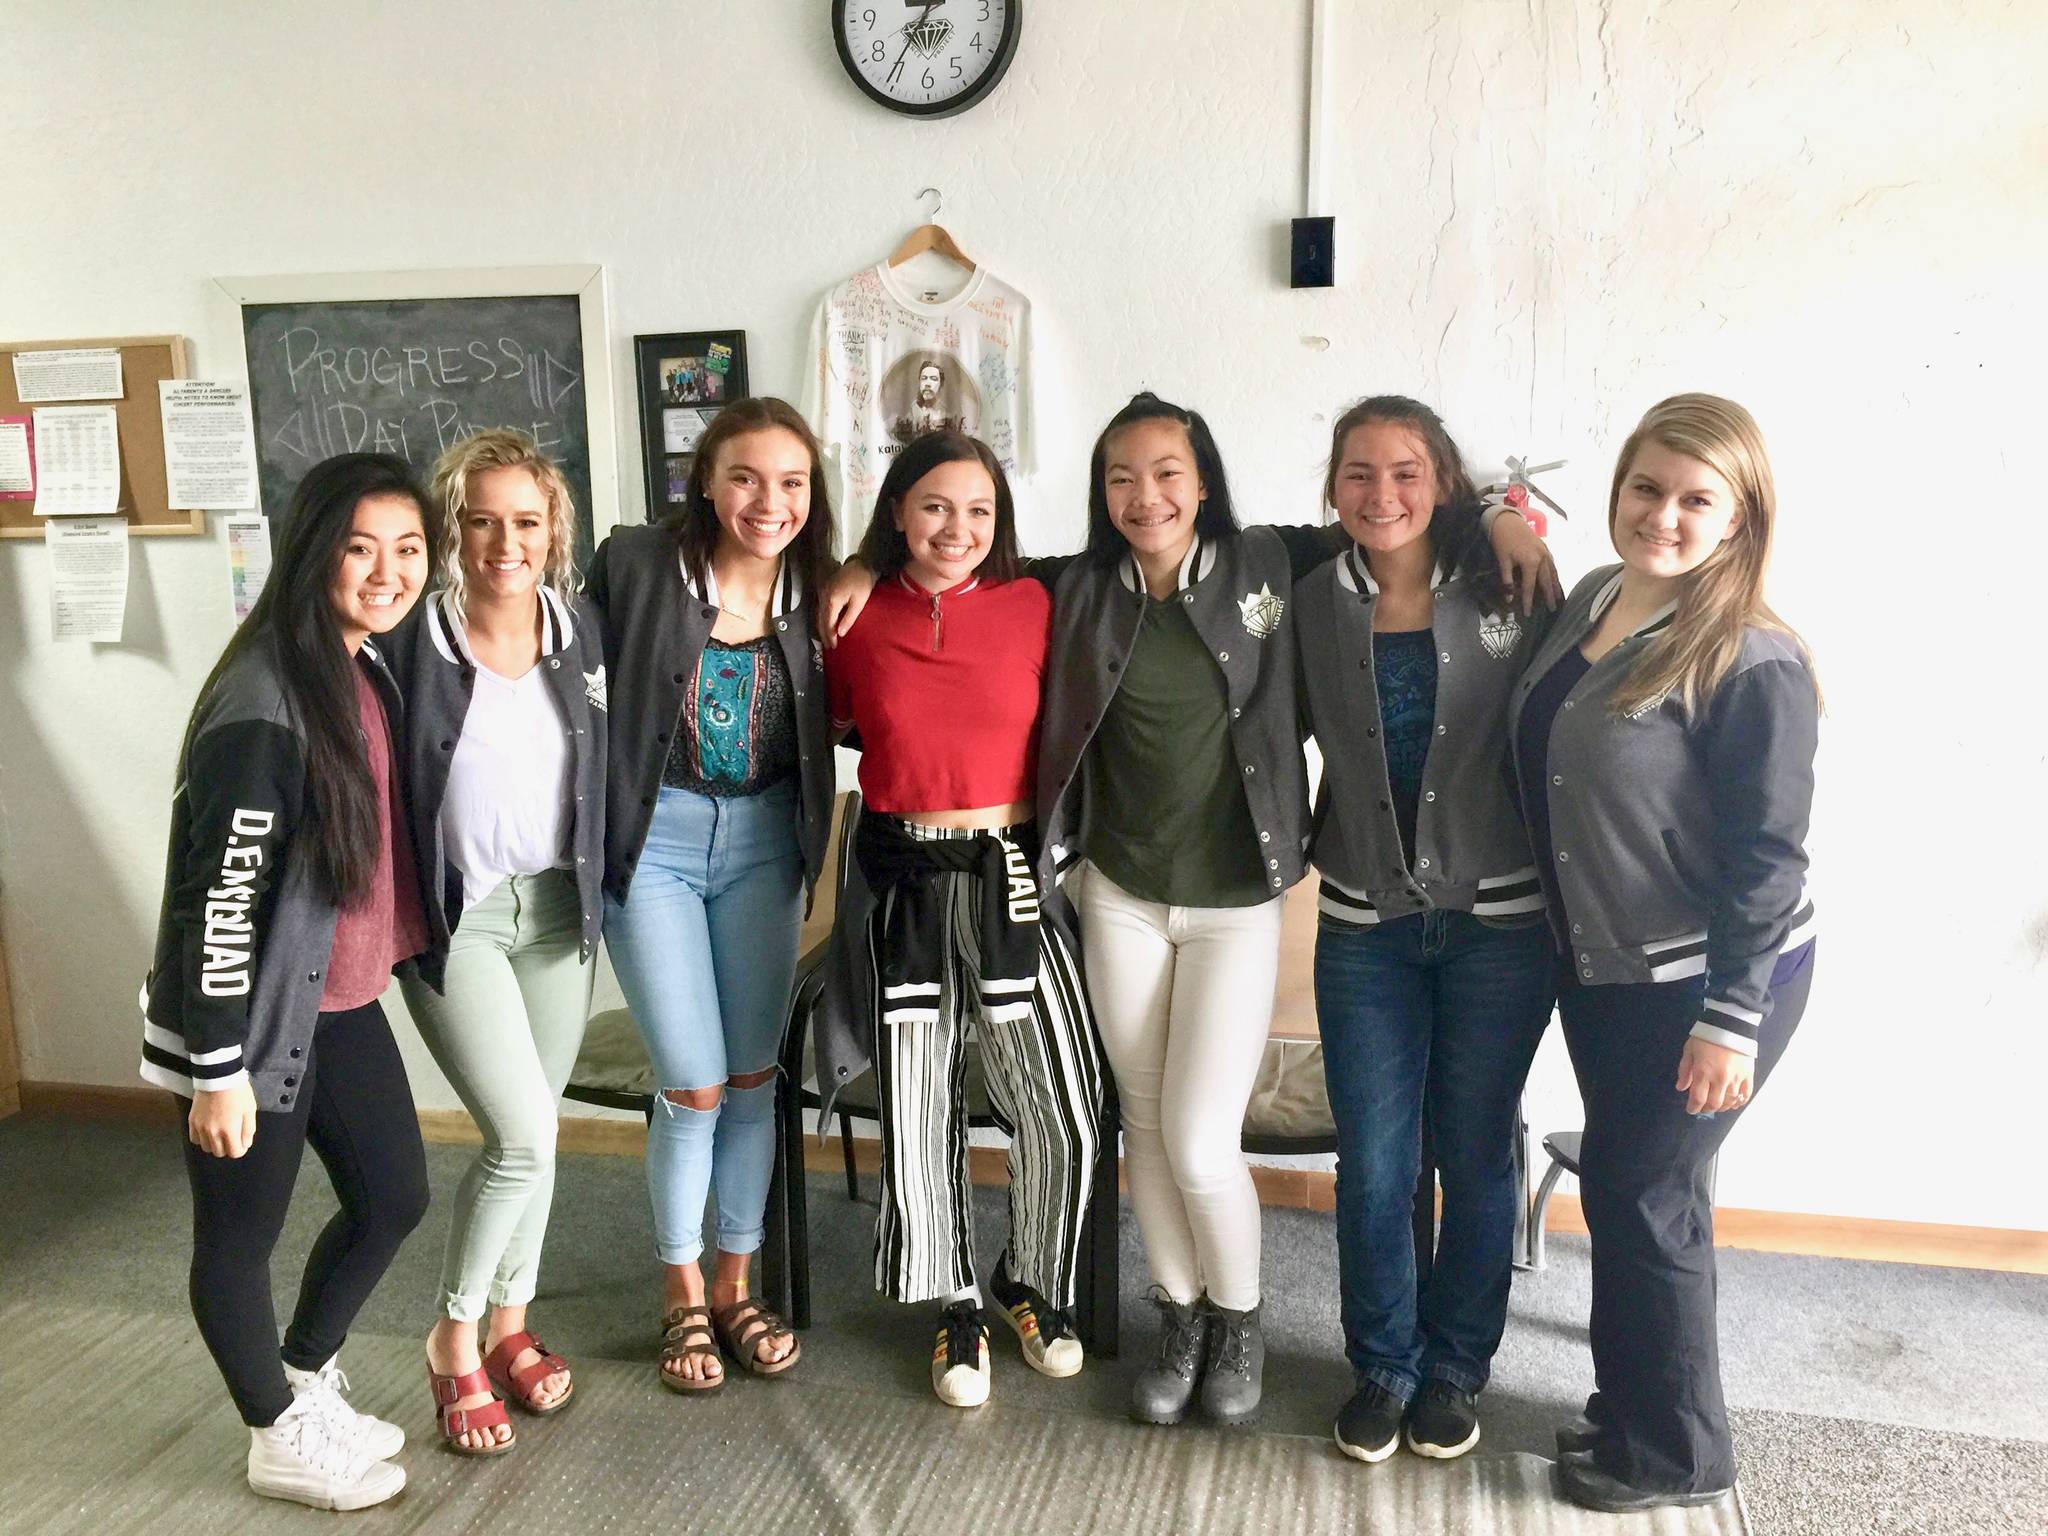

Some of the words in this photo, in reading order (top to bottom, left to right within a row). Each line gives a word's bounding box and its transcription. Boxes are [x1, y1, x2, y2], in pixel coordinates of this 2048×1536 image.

[862, 8, 876, 32] 9
[977, 0, 990, 22] 3
[872, 39, 885, 62] 8
[902, 37, 922, 58] DNCE
[969, 31, 982, 54] 4
[893, 61, 905, 84] 7
[921, 66, 935, 90] 6
[949, 55, 962, 79] 5
[277, 326, 526, 398] PROGRESS
[328, 399, 413, 465] DAY
